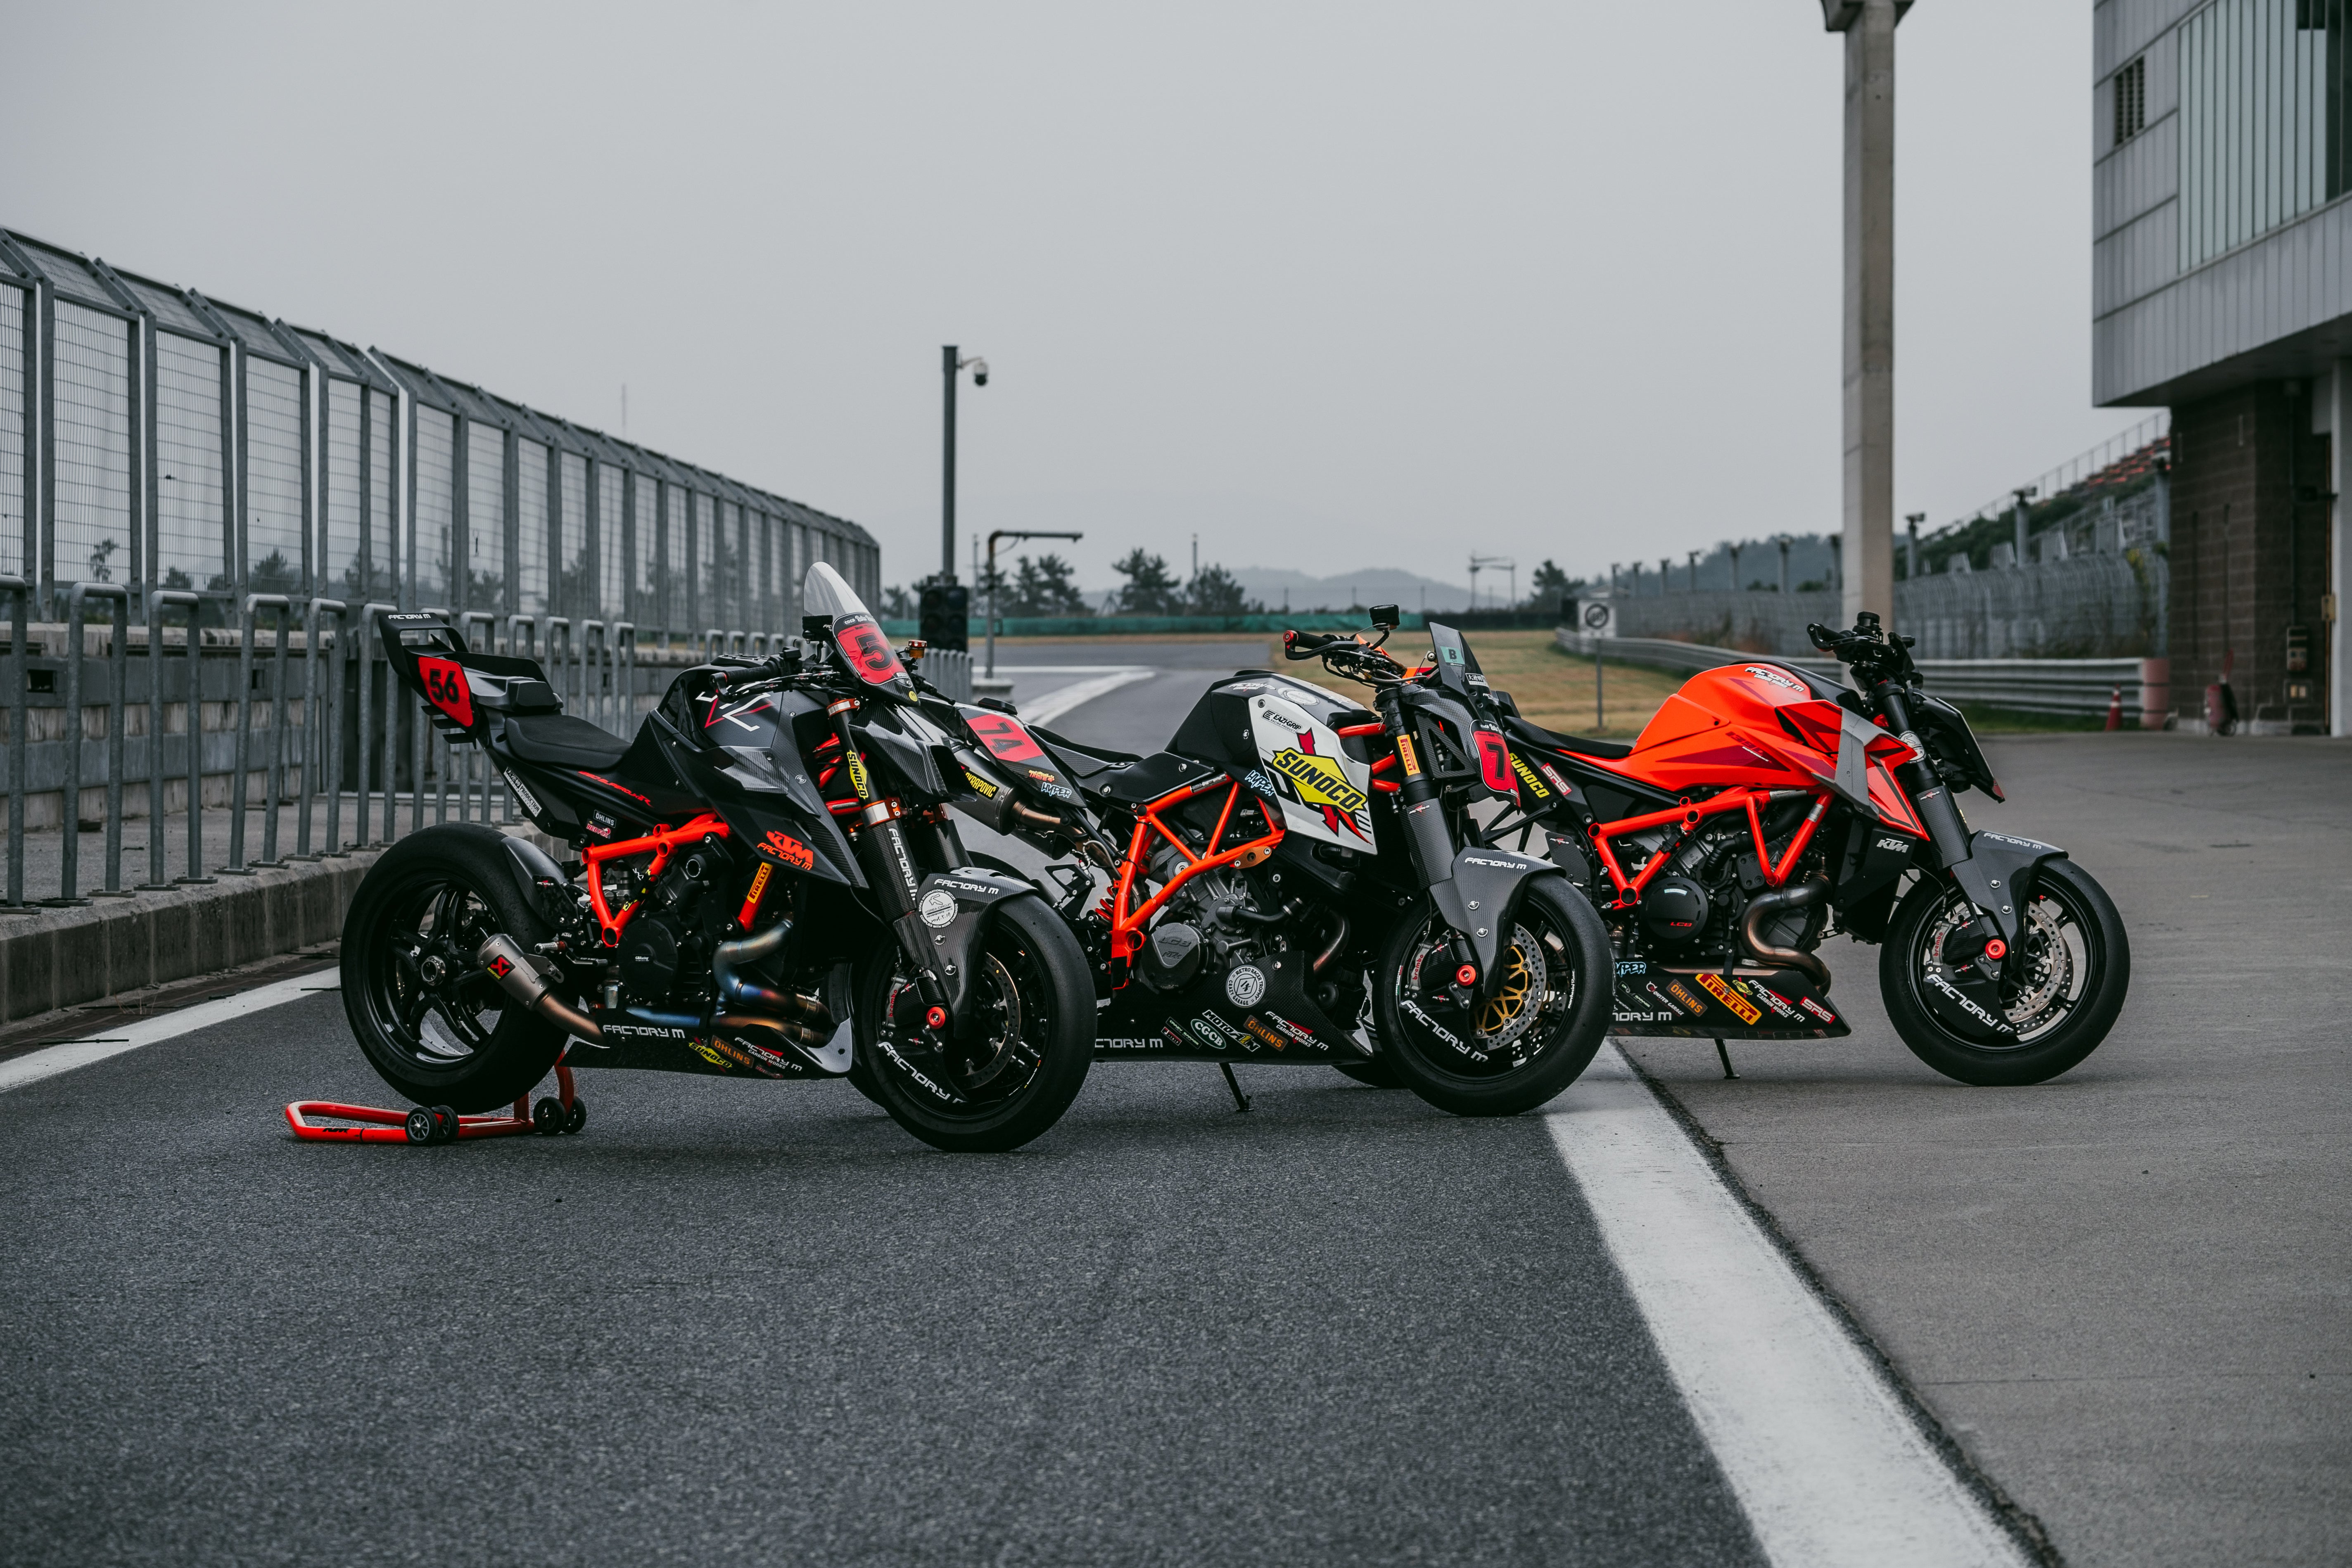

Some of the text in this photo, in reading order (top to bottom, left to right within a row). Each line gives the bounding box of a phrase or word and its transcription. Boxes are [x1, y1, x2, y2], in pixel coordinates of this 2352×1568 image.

[855, 633, 893, 671] 5
[1448, 649, 1457, 659] B
[430, 668, 459, 705] 56
[1745, 667, 1805, 692] FACTORY M
[975, 721, 1025, 754] 74
[1400, 738, 1416, 771] PIRELLI
[848, 754, 867, 796] SUNOCO
[1276, 752, 1363, 810] SUNOCO
[1509, 753, 1550, 798] SUNOCO
[520, 786, 541, 812] PRODUCTION
[1041, 782, 1072, 799] HYPER
[596, 811, 615, 826] ÖHLINS
[767, 830, 813, 864] KTM
[1877, 838, 1909, 853] KTM
[1984, 833, 2030, 847] FACTORY
[757, 842, 812, 870] FACTORY M
[889, 828, 916, 887] FACTORY
[1465, 857, 1515, 869] FACTORY
[749, 865, 769, 899] PIRELLI
[934, 878, 987, 892] FACTORY
[1933, 932, 1943, 957] brembo
[1251, 969, 1262, 981] RACER
[1412, 954, 1424, 980] brembo
[1615, 961, 1646, 977] YPER
[1233, 995, 1249, 1005] GARAGE
[1255, 981, 1263, 1000] TROPHY
[1671, 982, 1703, 1013] ÖHLINS
[1700, 974, 1758, 1022] PIRELLI
[1734, 980, 1752, 996] SUNOCO
[1749, 980, 1805, 1022] FACTORY M
[1668, 1002, 1684, 1016] GARAGE
[1756, 993, 1789, 1018] CARBON WORKS
[1801, 999, 1833, 1023] SRS
[1927, 974, 2014, 1032] FACTORY M
[1612, 1012, 1671, 1021] TORY M
[603, 1025, 685, 1039] FACTORY M
[1095, 1039, 1163, 1048] CTORY M
[1195, 1022, 1223, 1046] CGCB
[1248, 1018, 1283, 1048] ÖHLINS
[1265, 1011, 1329, 1050] FACTORY M
[1276, 1024, 1312, 1048] CARBON WORKS
[1401, 1000, 1488, 1062] FACTORY M
[691, 1042, 731, 1068] SUNOCO
[714, 1038, 750, 1065] ÖHLINS
[735, 1037, 790, 1066] FACTORY
[748, 1049, 786, 1070] CARBON WORKS
[878, 1041, 950, 1100] FACTORY
